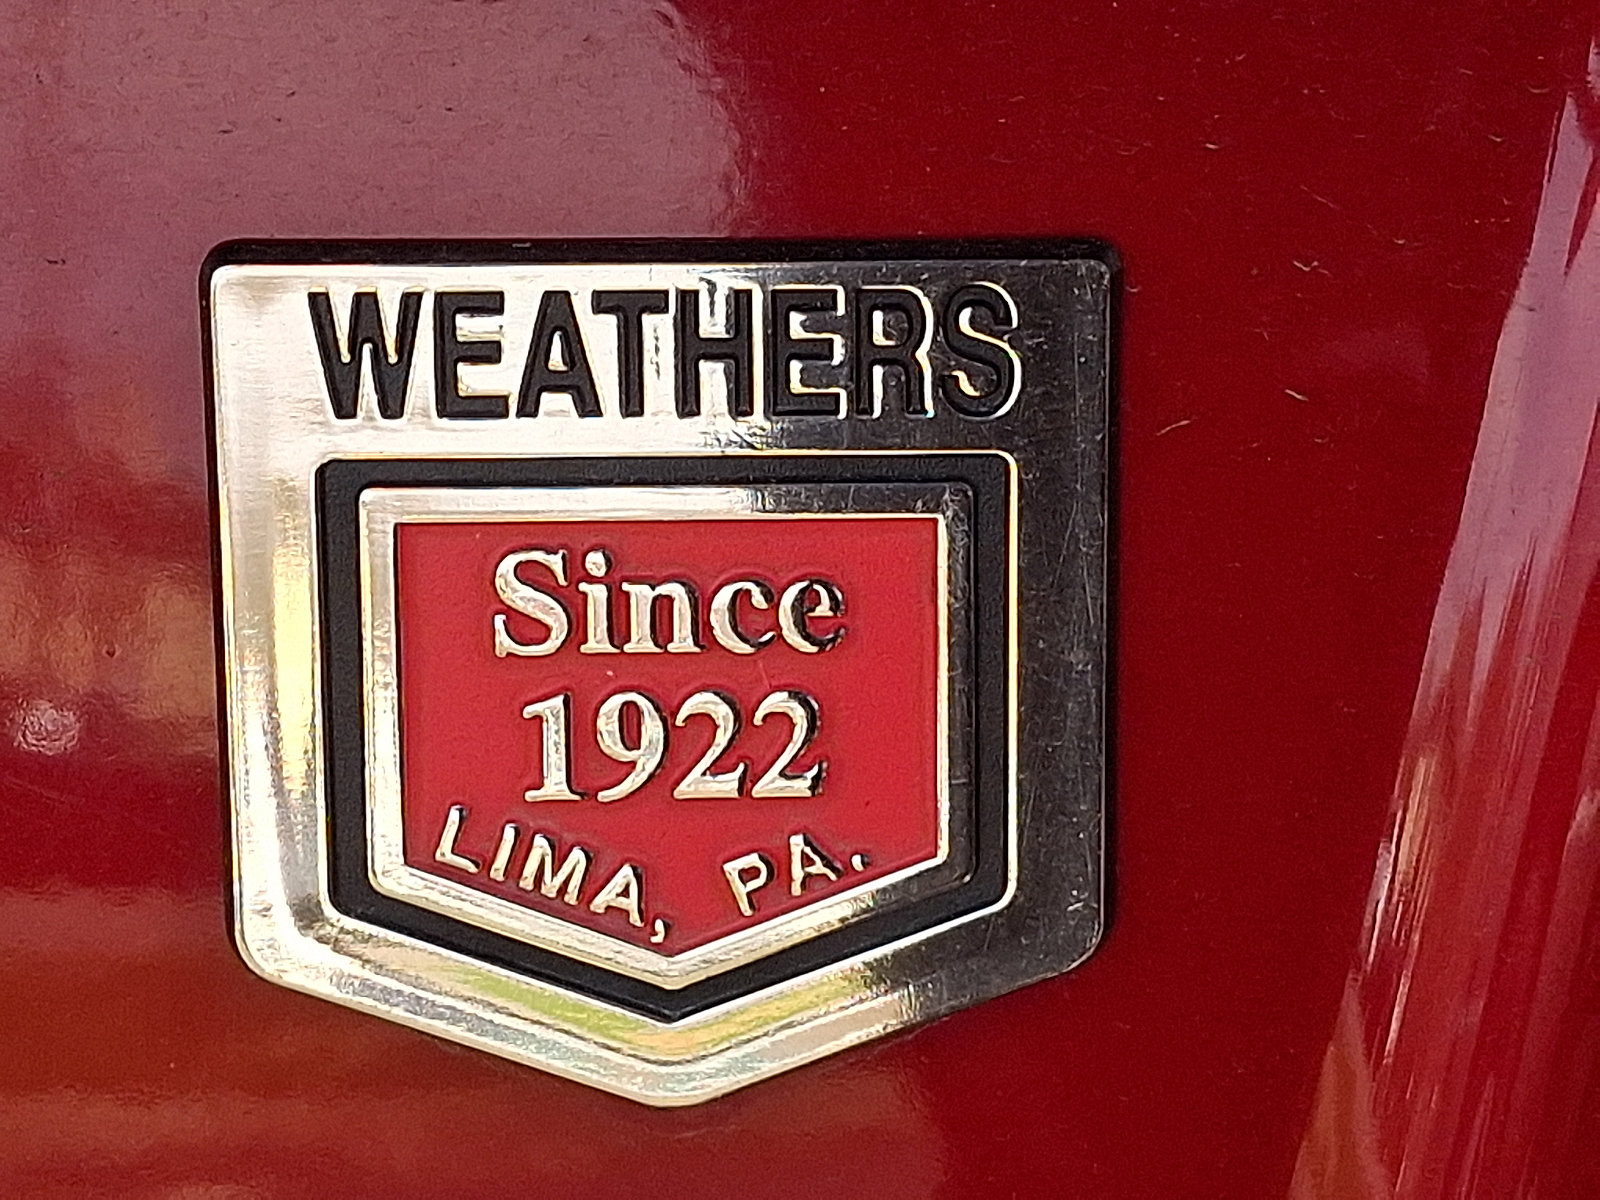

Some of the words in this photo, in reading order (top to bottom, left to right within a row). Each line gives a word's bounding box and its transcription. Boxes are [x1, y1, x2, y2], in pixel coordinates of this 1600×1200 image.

[307, 282, 1022, 420] WEATHERS
[494, 549, 846, 657] Since
[522, 690, 828, 803] 1922
[434, 804, 671, 944] LIMA,
[722, 832, 871, 917] PA.
